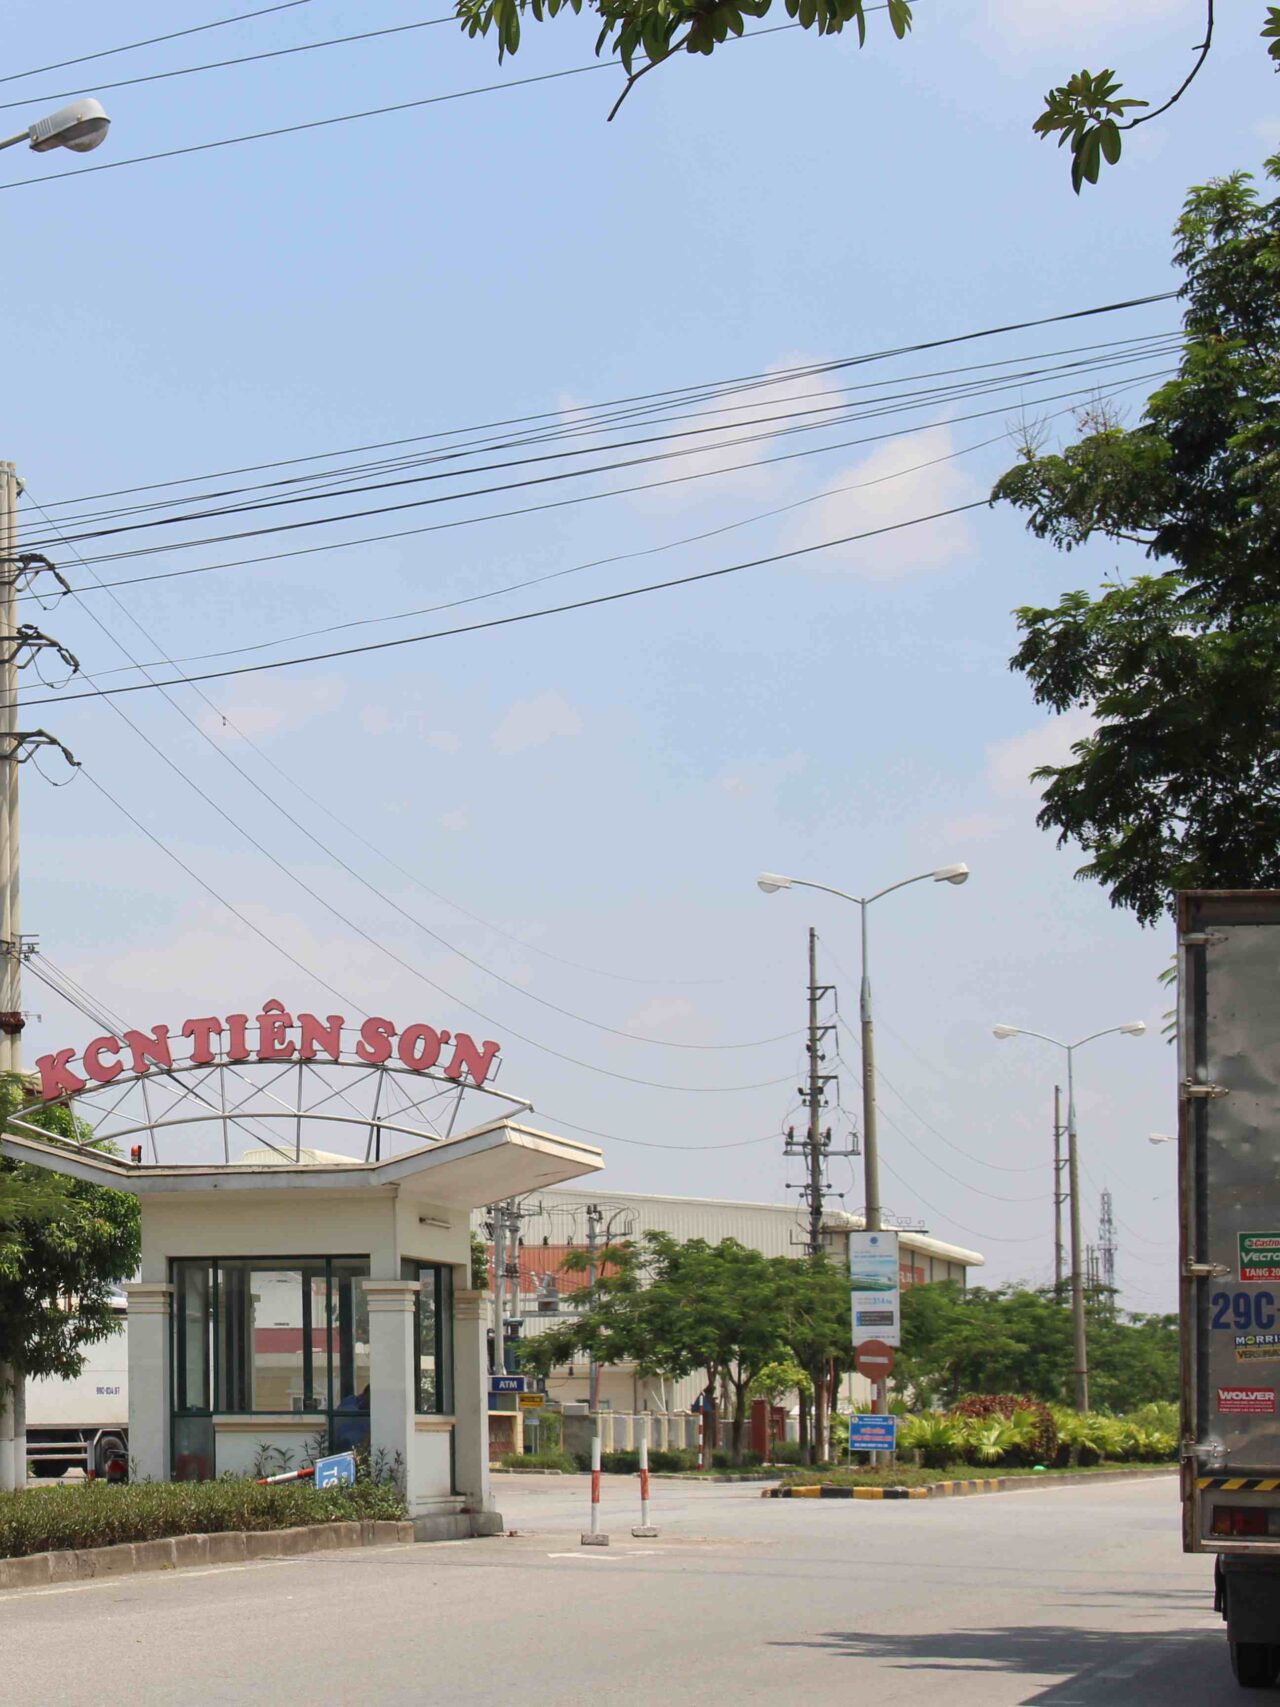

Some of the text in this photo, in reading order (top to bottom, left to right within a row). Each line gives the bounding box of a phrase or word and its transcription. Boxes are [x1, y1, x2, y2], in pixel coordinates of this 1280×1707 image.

[35, 998, 501, 1100] KCN TIÊN SƠN
[1235, 1335, 1280, 1345] MORRI
[499, 1380, 518, 1389] ATM
[1218, 1389, 1275, 1400] WOLVER
